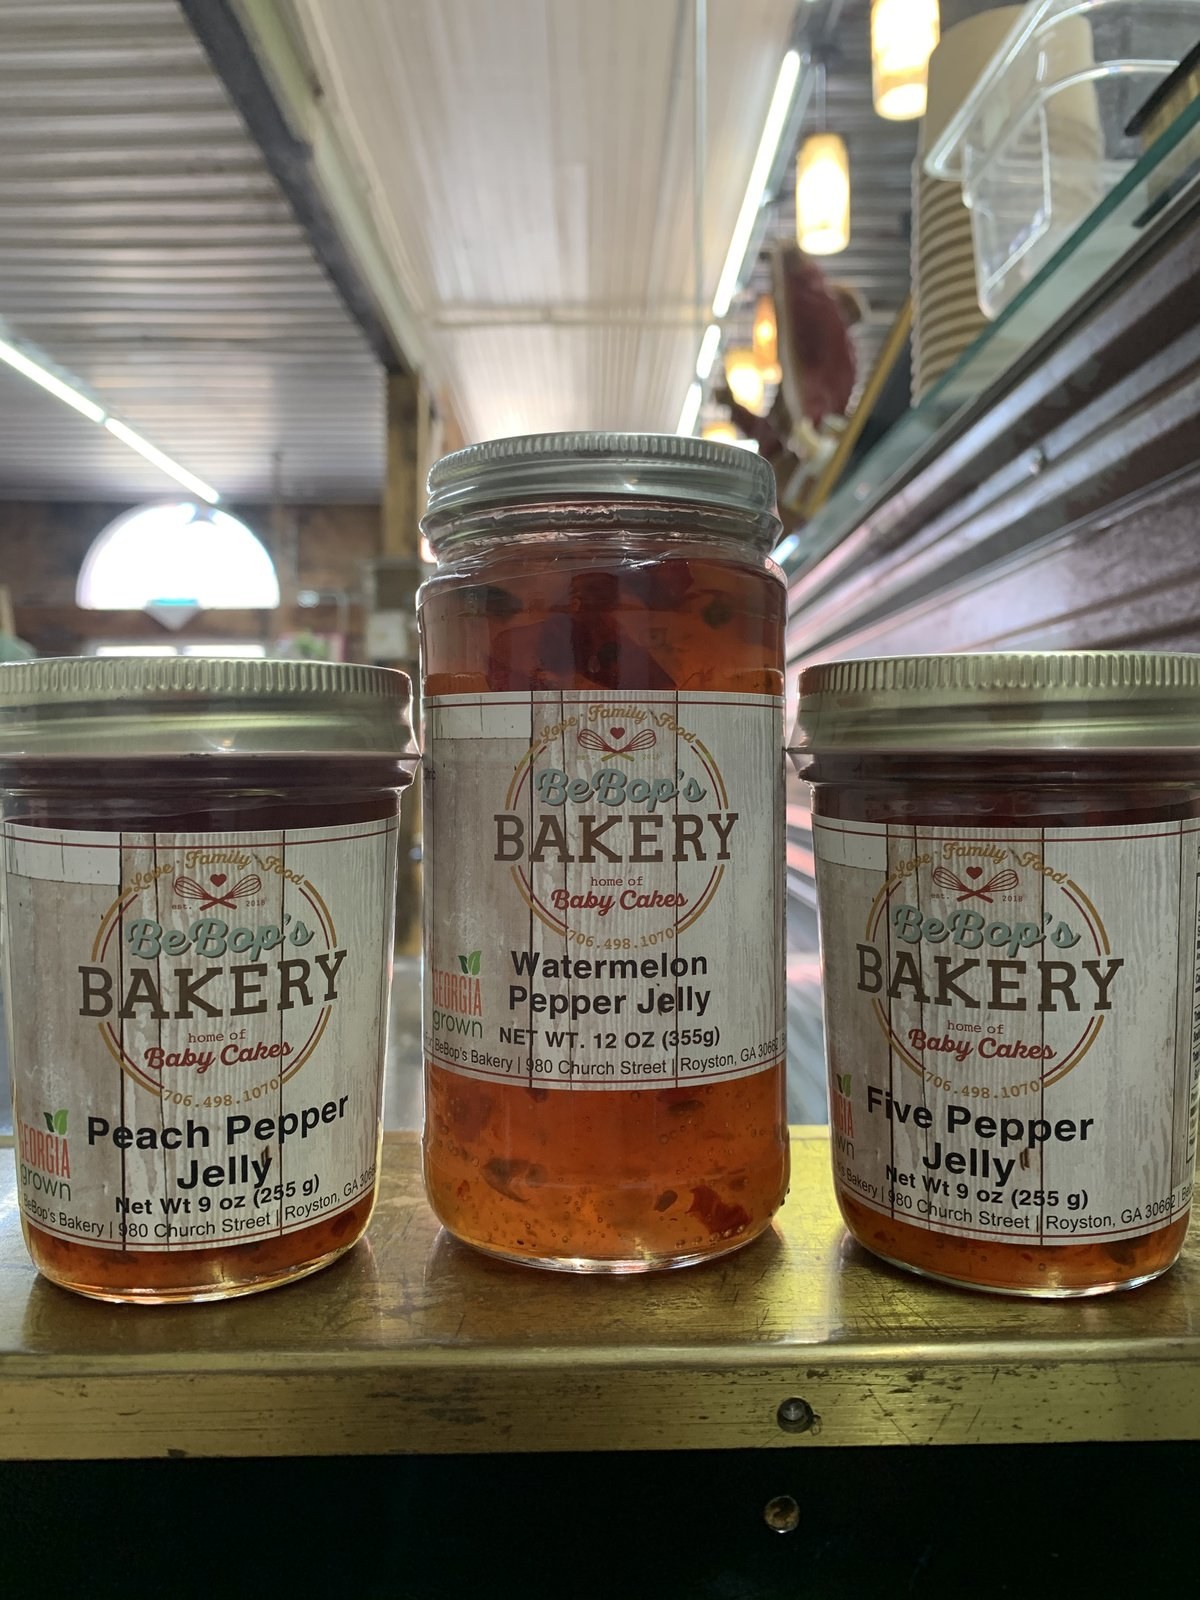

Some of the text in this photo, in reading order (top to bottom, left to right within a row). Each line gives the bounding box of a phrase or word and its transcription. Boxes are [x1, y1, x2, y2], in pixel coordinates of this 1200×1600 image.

[540, 703, 697, 743] Love Family Food
[535, 768, 707, 812] BeBop's
[494, 812, 739, 864] BAKERY
[130, 850, 305, 891] Love Family Food
[591, 875, 644, 887] home of
[895, 842, 1068, 884] Love Family Food
[551, 889, 689, 916] Baby Cakes
[1002, 895, 1023, 903] 2018
[127, 913, 314, 961] BeBop's
[568, 927, 675, 951] 706.498.1070
[891, 904, 1081, 957] BeBop's
[511, 950, 708, 979] Watermelon
[856, 943, 1124, 1013] BAKERY
[78, 950, 348, 1020] BAKERY
[432, 969, 482, 1016] GEORGIA
[509, 985, 711, 1019] Pepper Jelly
[188, 1028, 247, 1043] home of
[433, 1010, 482, 1039] grown
[500, 1027, 720, 1051] NET WT. 12 OZ (355g)
[947, 1020, 1004, 1035] home of
[143, 1039, 294, 1073] Baby Cakes
[435, 1038, 468, 1062] BeBop's
[471, 1050, 513, 1072] Bakery
[526, 1059, 554, 1074] 980
[558, 1060, 615, 1076] Church
[620, 1059, 667, 1075] Street
[680, 1054, 737, 1073] Royston,
[741, 1046, 756, 1062] GA
[908, 1028, 1057, 1063] Baby Cakes
[164, 1078, 280, 1108] 706.498.1070
[925, 1072, 1040, 1099] 706.498.1070
[87, 1095, 349, 1150] Peach Pepper
[867, 1085, 934, 1129] Five
[947, 1105, 1094, 1149] Pepper
[20, 1163, 71, 1201] grown
[177, 1154, 272, 1189] Jelly
[923, 1142, 1016, 1187] Jelly
[115, 1174, 320, 1215] Net Wt 9 oz (255 g)
[846, 1168, 878, 1199] Bakery
[888, 1189, 912, 1209] 980
[916, 1198, 973, 1224] Church
[978, 1210, 1030, 1230] Street
[1046, 1212, 1116, 1232] Royston,
[1121, 1207, 1142, 1224] GA
[1145, 1194, 1176, 1219] 30662
[886, 1164, 1089, 1211] Net Wt 9 oz (255 g)
[59, 1212, 104, 1238] Bakery
[118, 1222, 149, 1238] 980
[154, 1219, 216, 1239] Church
[222, 1212, 271, 1234] Street
[285, 1192, 340, 1220] Royston,
[343, 1179, 358, 1197] GA
